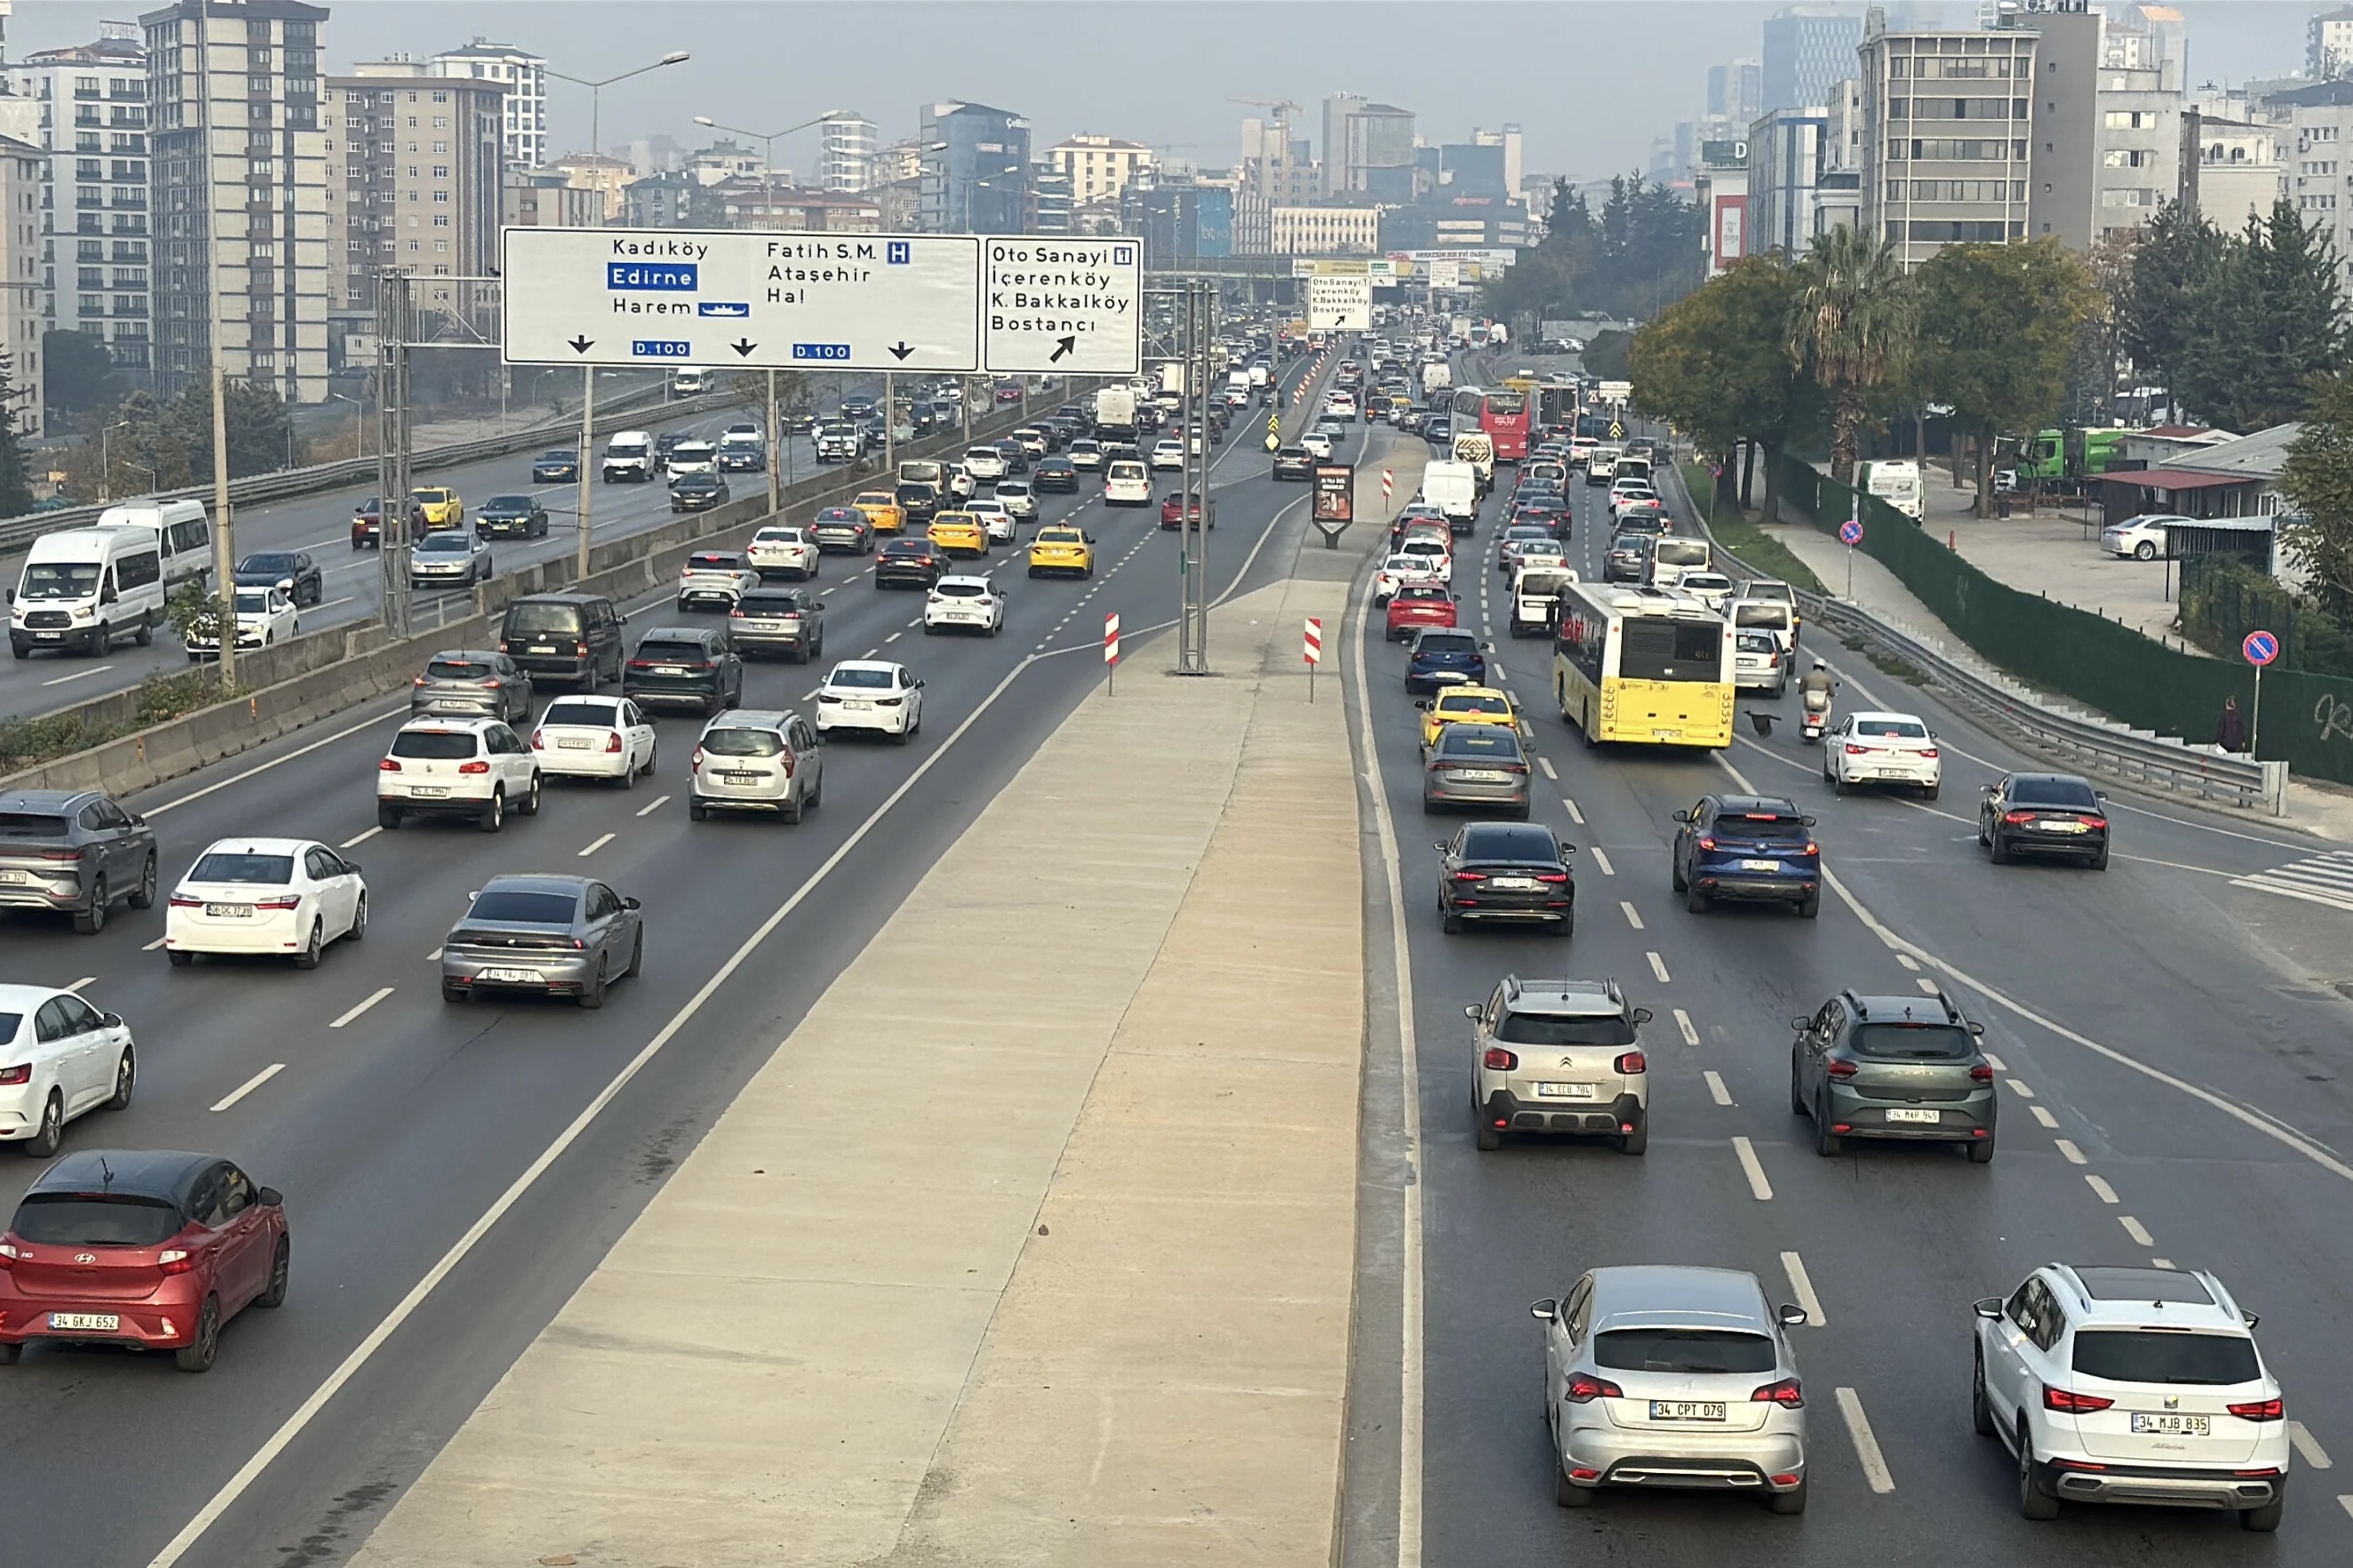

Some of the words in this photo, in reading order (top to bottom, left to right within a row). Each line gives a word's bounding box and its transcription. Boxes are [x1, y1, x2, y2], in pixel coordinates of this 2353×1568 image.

[612, 238, 708, 260] Kadıköy
[768, 242, 828, 259] Fatih
[837, 243, 877, 260] S.M.
[890, 244, 906, 262] H
[993, 246, 1028, 262] Oto
[1035, 247, 1108, 267] Sanayi
[613, 268, 692, 286] Edirne
[768, 265, 871, 284] Ataşehir
[992, 265, 1110, 291] İçerenköy
[768, 288, 804, 304] Hal
[992, 292, 1009, 307] K.
[1015, 292, 1129, 314] Bakkalköy
[613, 298, 691, 315] Harem
[992, 315, 1095, 332] Bostancı
[636, 343, 687, 355] D.100
[796, 346, 847, 358] D.100
[55, 1315, 67, 1326] 34
[73, 1316, 93, 1327] GKJ
[96, 1316, 116, 1328] 652
[1657, 1403, 1670, 1415] 34
[1677, 1403, 1697, 1416] CPT
[1703, 1404, 1723, 1417] 079
[2139, 1415, 2153, 1429] 34
[2159, 1417, 2180, 1429] MJB
[2186, 1417, 2206, 1430] 835
